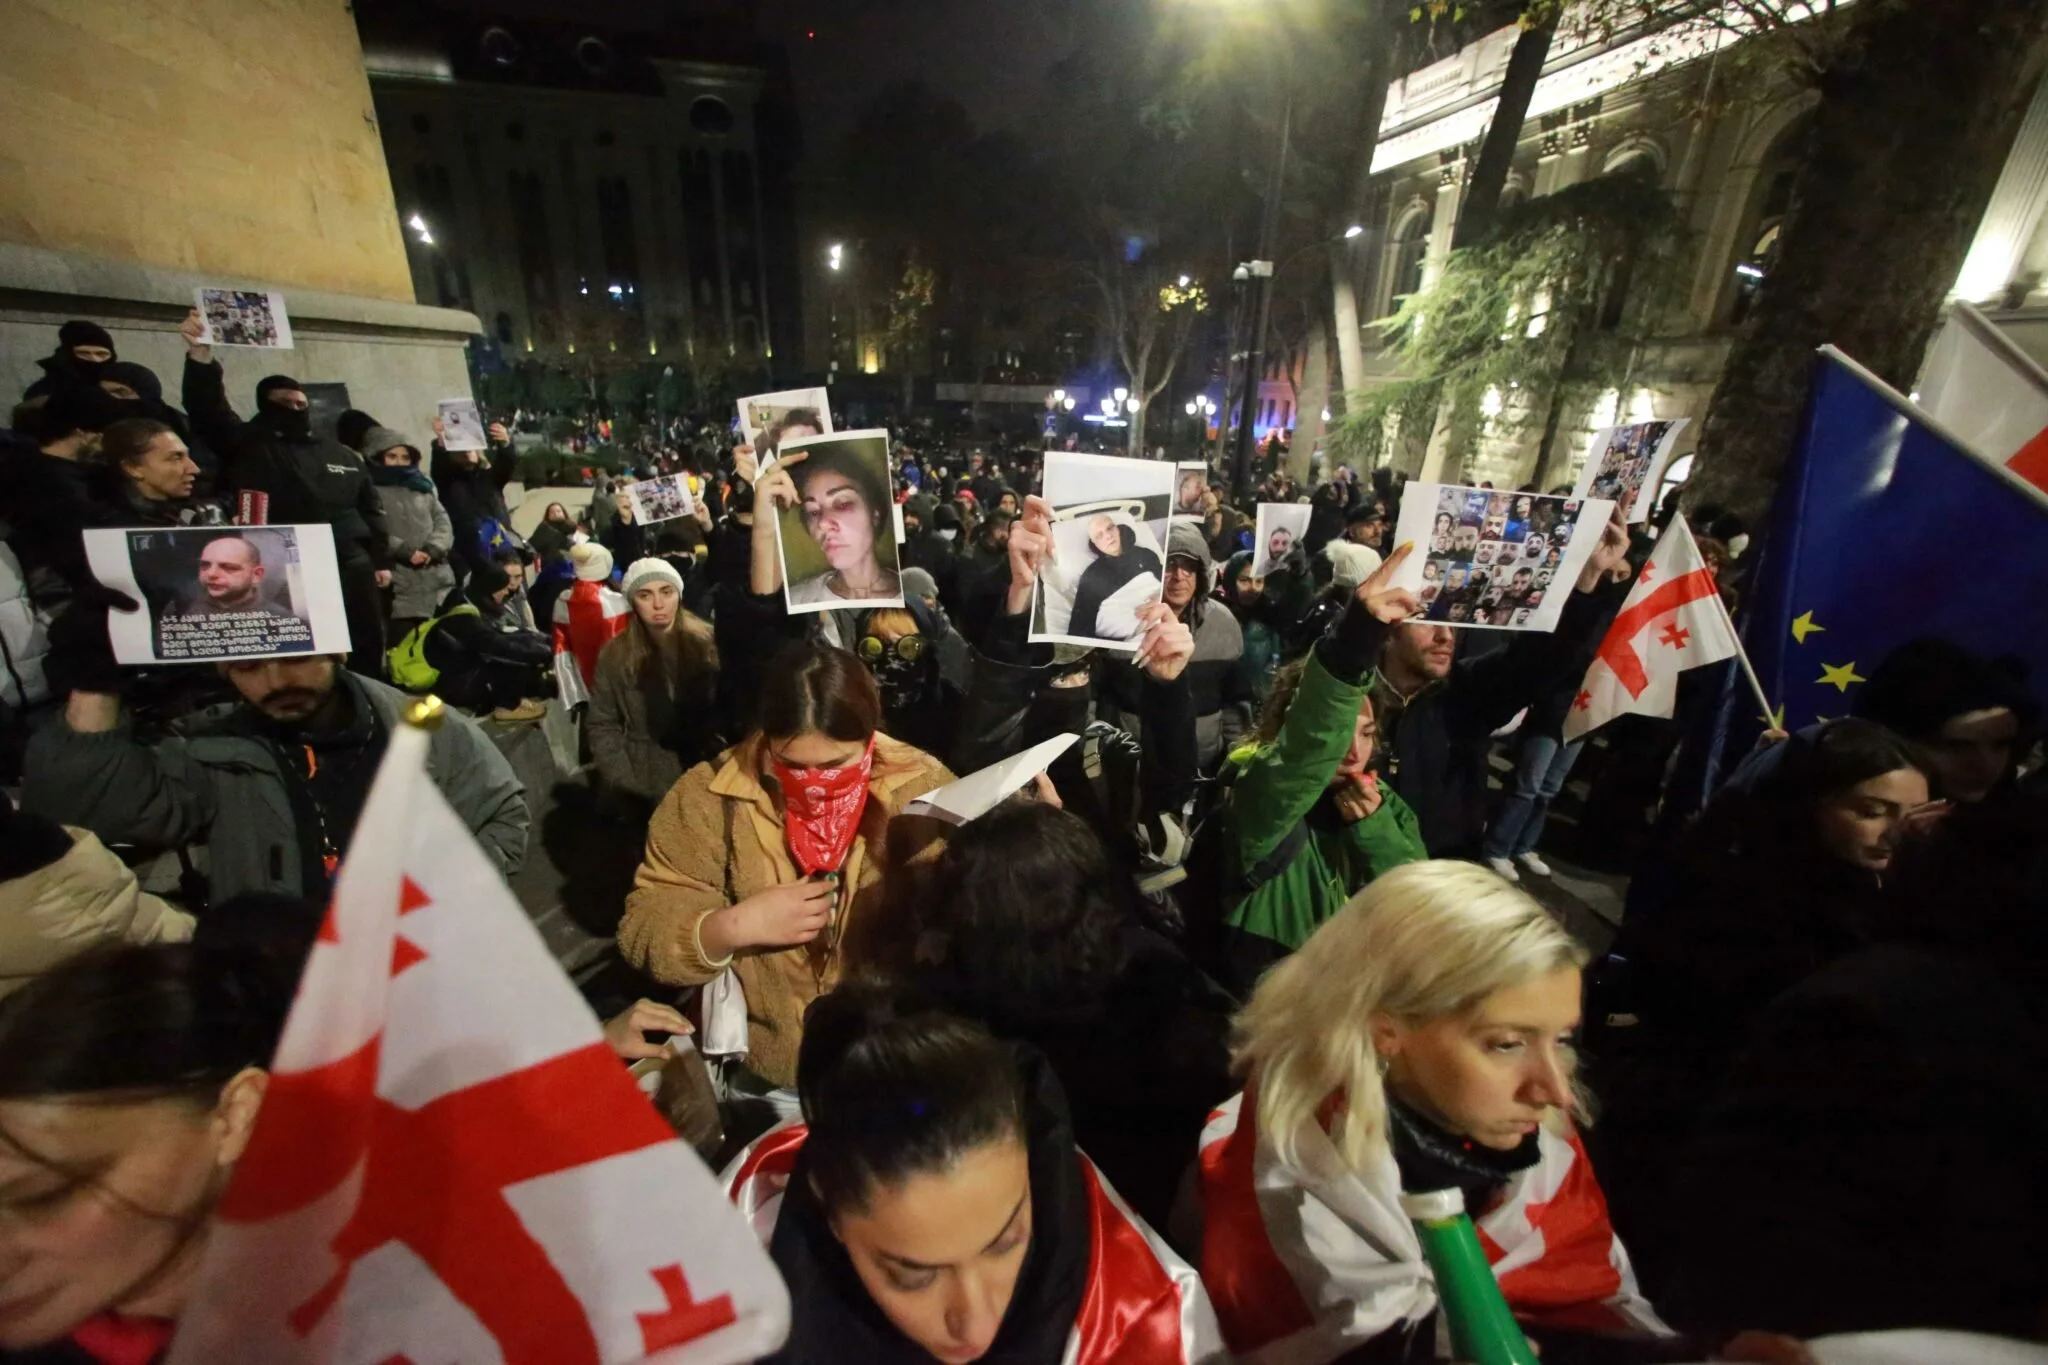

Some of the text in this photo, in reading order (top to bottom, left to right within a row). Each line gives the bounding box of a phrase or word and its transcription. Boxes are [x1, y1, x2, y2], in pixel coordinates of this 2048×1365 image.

[180, 615, 206, 623] კაცი
[161, 632, 174, 640] და
[176, 630, 221, 639] მეორეს
[223, 628, 269, 638] ეუბნება
[162, 640, 187, 649] ხელი
[267, 633, 311, 643] დაიწყეს
[163, 649, 189, 657] ჩემი
[193, 646, 225, 656] ხელის
